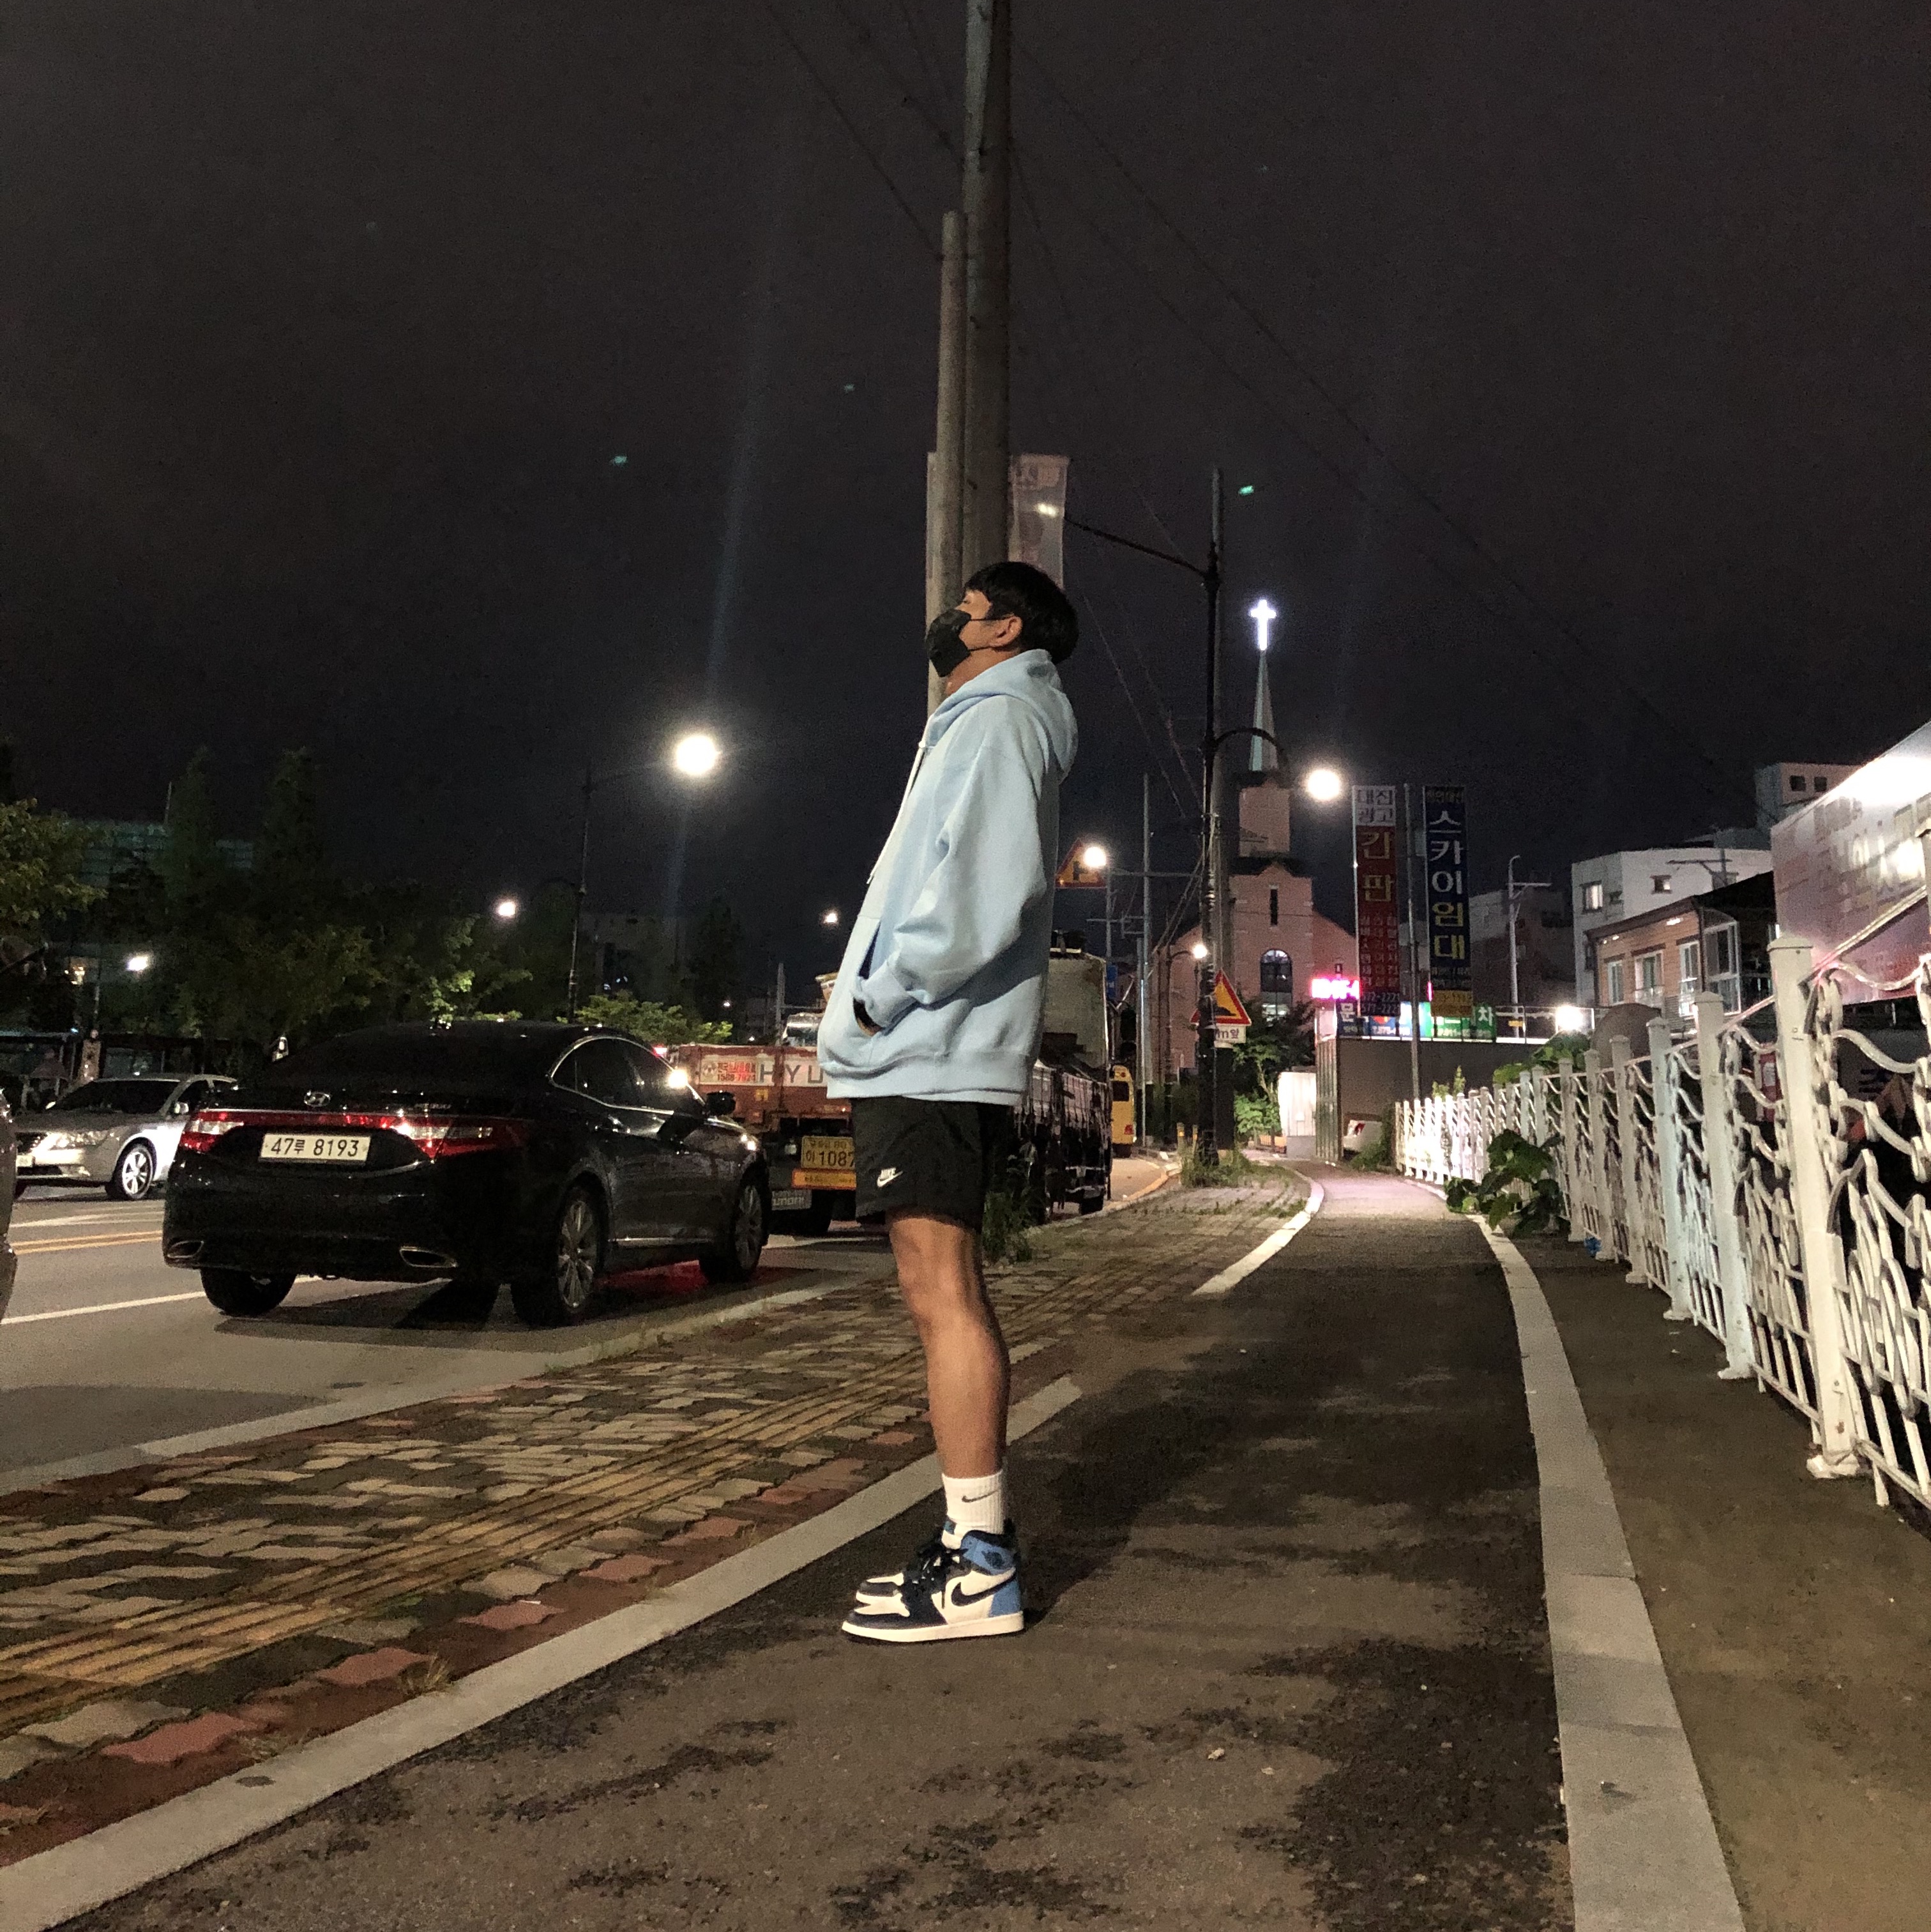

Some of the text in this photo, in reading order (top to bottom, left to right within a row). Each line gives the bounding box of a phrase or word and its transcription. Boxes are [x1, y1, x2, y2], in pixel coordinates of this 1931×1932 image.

[1359, 831, 1395, 902] 간판
[1428, 810, 1465, 959] 스카이임대
[271, 1137, 360, 1157] 47루 8193
